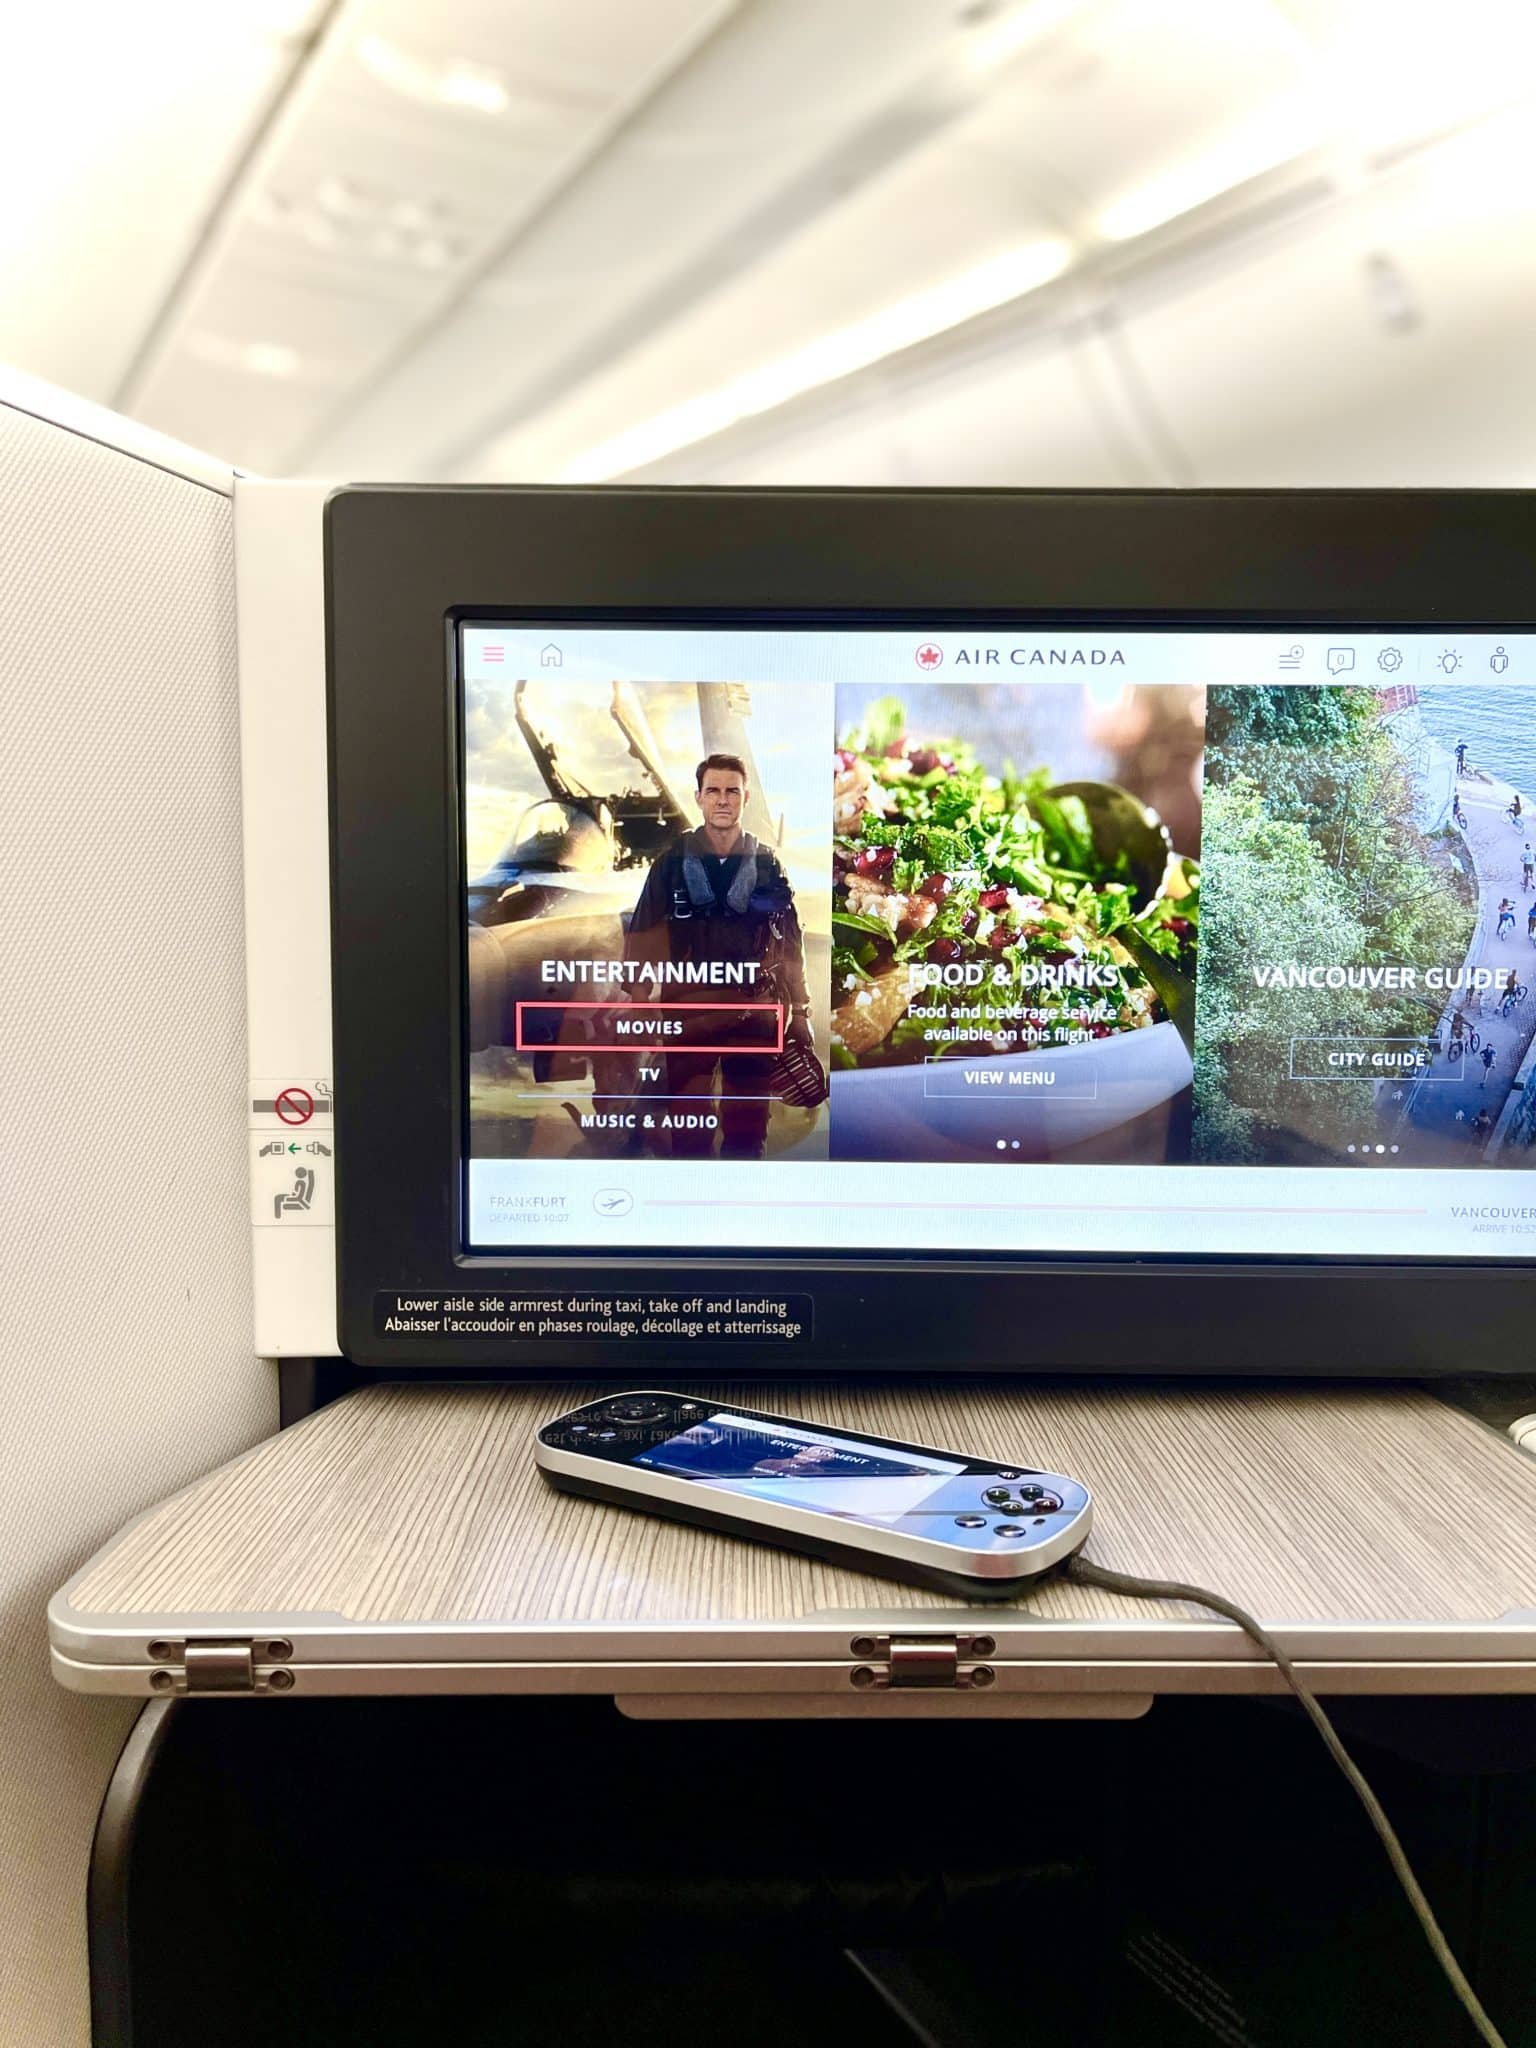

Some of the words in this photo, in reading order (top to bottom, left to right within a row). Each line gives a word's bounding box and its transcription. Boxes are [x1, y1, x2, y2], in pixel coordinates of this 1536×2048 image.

[955, 649, 1000, 665] AIR
[1010, 649, 1126, 666] CANADA
[541, 960, 761, 984] ENTERTAINMENT
[908, 964, 984, 986] FOOD
[992, 964, 1013, 986] &
[1021, 964, 1118, 988] DRINKS
[1253, 966, 1416, 989] VANCOUVER
[1424, 967, 1510, 990] GUIDE
[908, 1004, 947, 1019] Food
[951, 1004, 981, 1019] and
[985, 1005, 1058, 1023] beverage
[1062, 1006, 1117, 1021] service
[616, 1020, 683, 1035] MOVIES
[924, 1027, 993, 1041] available
[998, 1031, 1017, 1041] on
[1021, 1027, 1051, 1041] this
[1328, 1053, 1363, 1067] CITY
[1371, 1053, 1426, 1067] GUIDE
[639, 1067, 661, 1082] TV
[964, 1071, 1003, 1085] VIEW
[1009, 1071, 1055, 1086] MENU
[581, 1115, 636, 1129] MUSIC
[642, 1115, 656, 1129] &
[661, 1115, 719, 1129] AUDIO
[490, 1197, 567, 1208] FRANKFURT
[1451, 1207, 1536, 1219] VANCOUVER
[1472, 1224, 1507, 1233] ARRIVE
[397, 1297, 439, 1312] Lower
[443, 1298, 474, 1312] aisle
[479, 1298, 505, 1312] side
[509, 1300, 564, 1312] armrest
[567, 1299, 613, 1316] during
[616, 1299, 646, 1314] taxi,
[649, 1299, 679, 1313] take
[682, 1299, 703, 1313] off
[706, 1299, 732, 1314] and
[736, 1299, 787, 1318] landing
[384, 1317, 440, 1332] Abaisser
[443, 1318, 515, 1332] l'accoudoir
[518, 1321, 535, 1332] en
[538, 1320, 584, 1336] phases
[586, 1319, 639, 1335] roulage,
[641, 1318, 704, 1338] décollage
[706, 1321, 721, 1334] et
[724, 1320, 801, 1338] atterrissage
